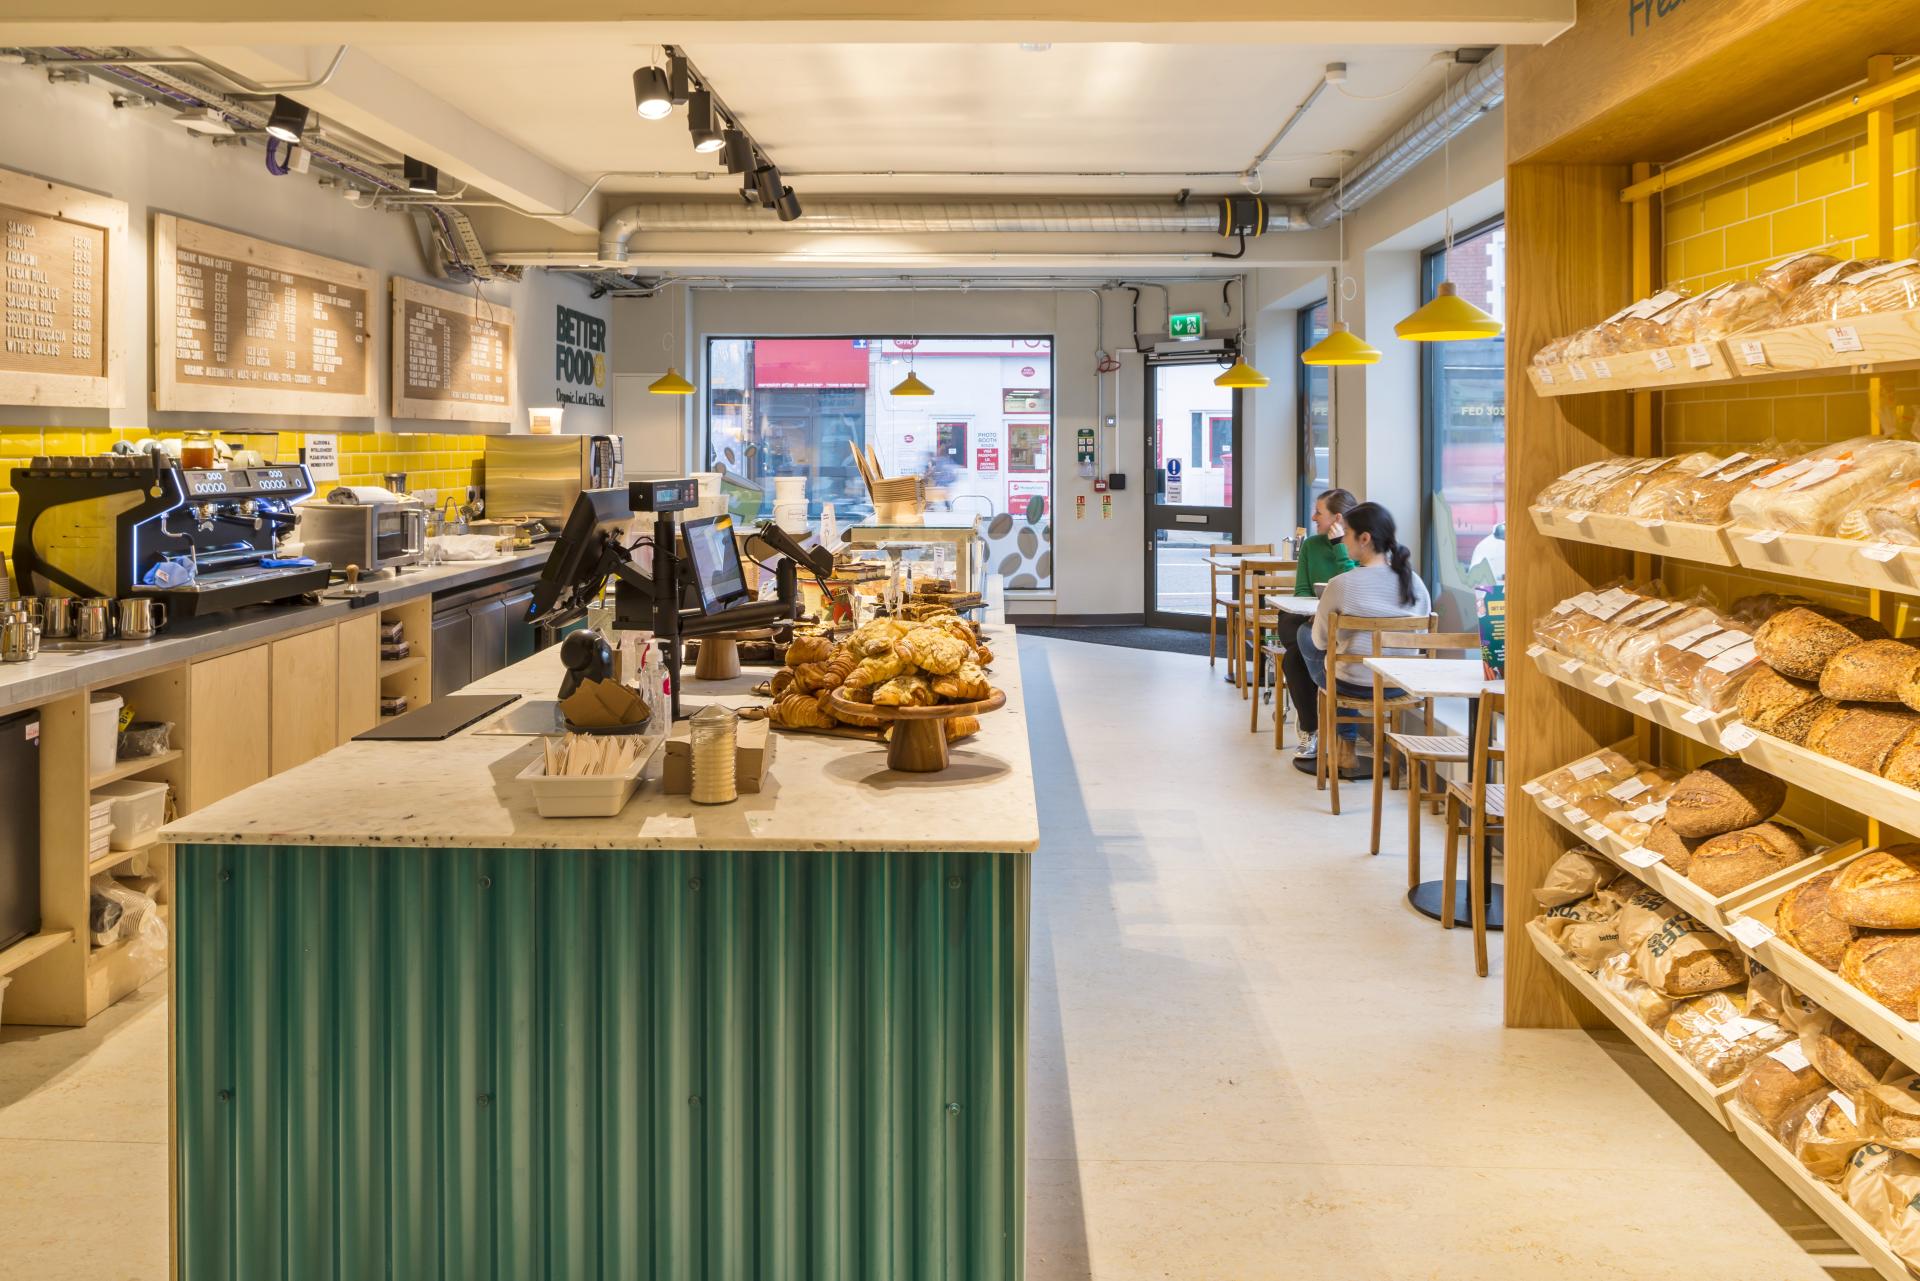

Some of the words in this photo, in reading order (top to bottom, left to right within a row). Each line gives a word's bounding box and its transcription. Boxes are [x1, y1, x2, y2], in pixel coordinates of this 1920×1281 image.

[7, 220, 35, 238] SAMOSA
[30, 269, 48, 284] ROLL
[39, 300, 56, 314] ROLL
[557, 304, 606, 353] BETTER
[6, 339, 25, 355] WITH
[33, 343, 60, 357] SALADS
[556, 343, 594, 386] FOOD
